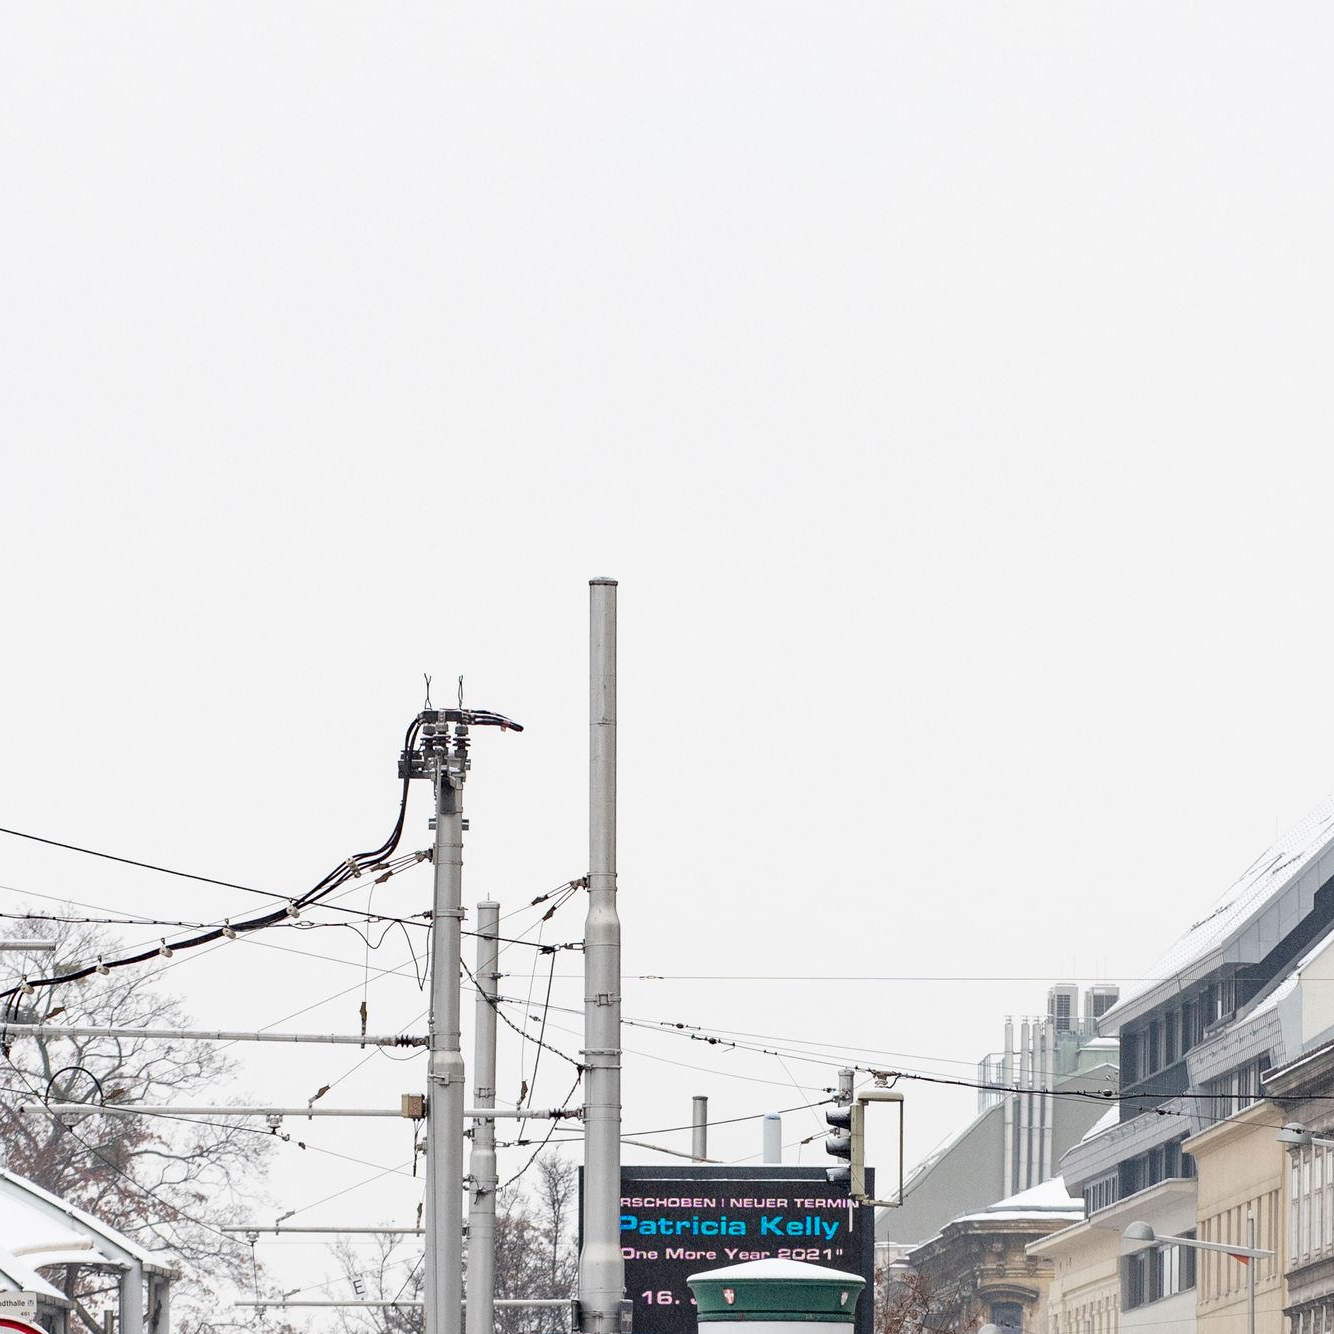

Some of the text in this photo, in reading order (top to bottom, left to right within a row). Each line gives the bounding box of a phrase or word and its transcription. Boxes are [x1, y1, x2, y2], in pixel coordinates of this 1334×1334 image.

[620, 1198, 716, 1208] RSCHOBEN
[730, 1198, 788, 1208] NEUER
[794, 1199, 860, 1209] TERMIN
[619, 1215, 840, 1240] Patricia Kelly
[665, 1248, 717, 1260] More
[725, 1248, 771, 1260] Year
[641, 1290, 680, 1305] 16.
